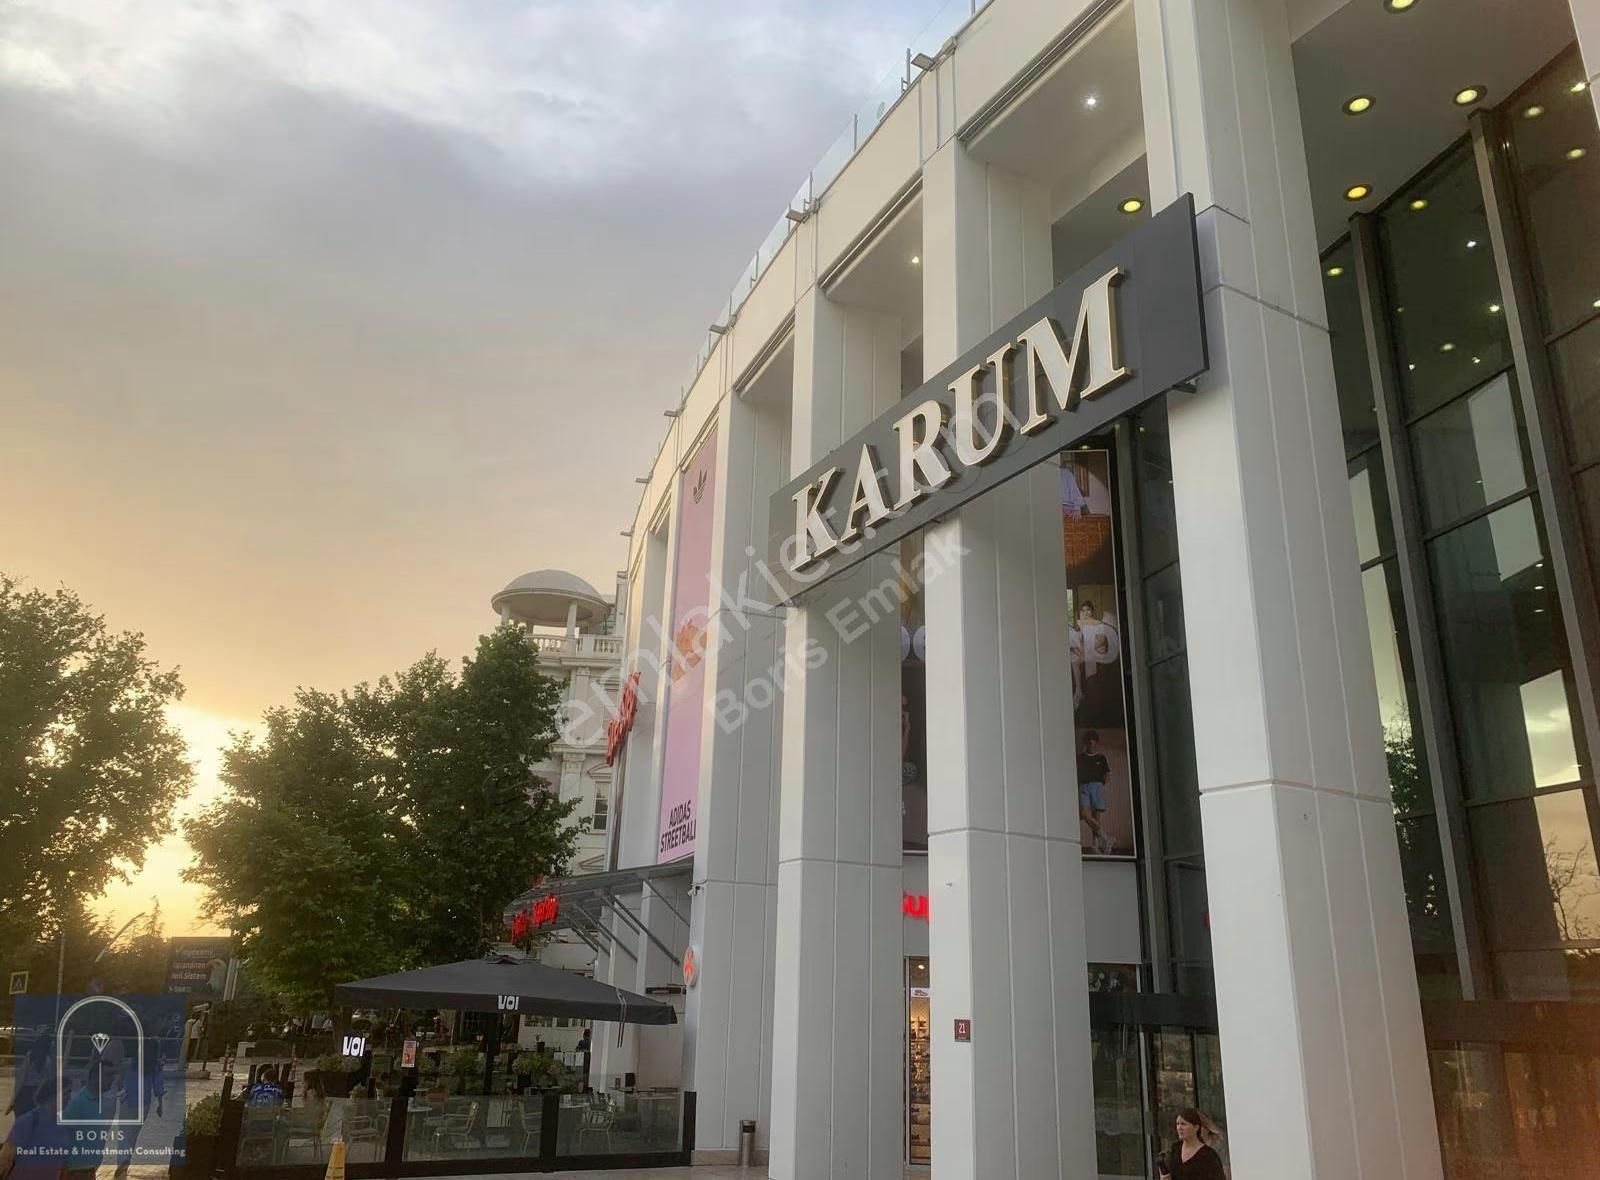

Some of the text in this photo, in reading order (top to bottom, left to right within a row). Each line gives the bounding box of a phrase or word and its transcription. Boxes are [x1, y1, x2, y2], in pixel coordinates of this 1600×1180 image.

[790, 265, 1133, 572] KARUM
[669, 799, 691, 828] ADIDAS
[497, 995, 520, 1010] VOI
[958, 1022, 967, 1034] 21
[342, 1036, 366, 1057] VOI
